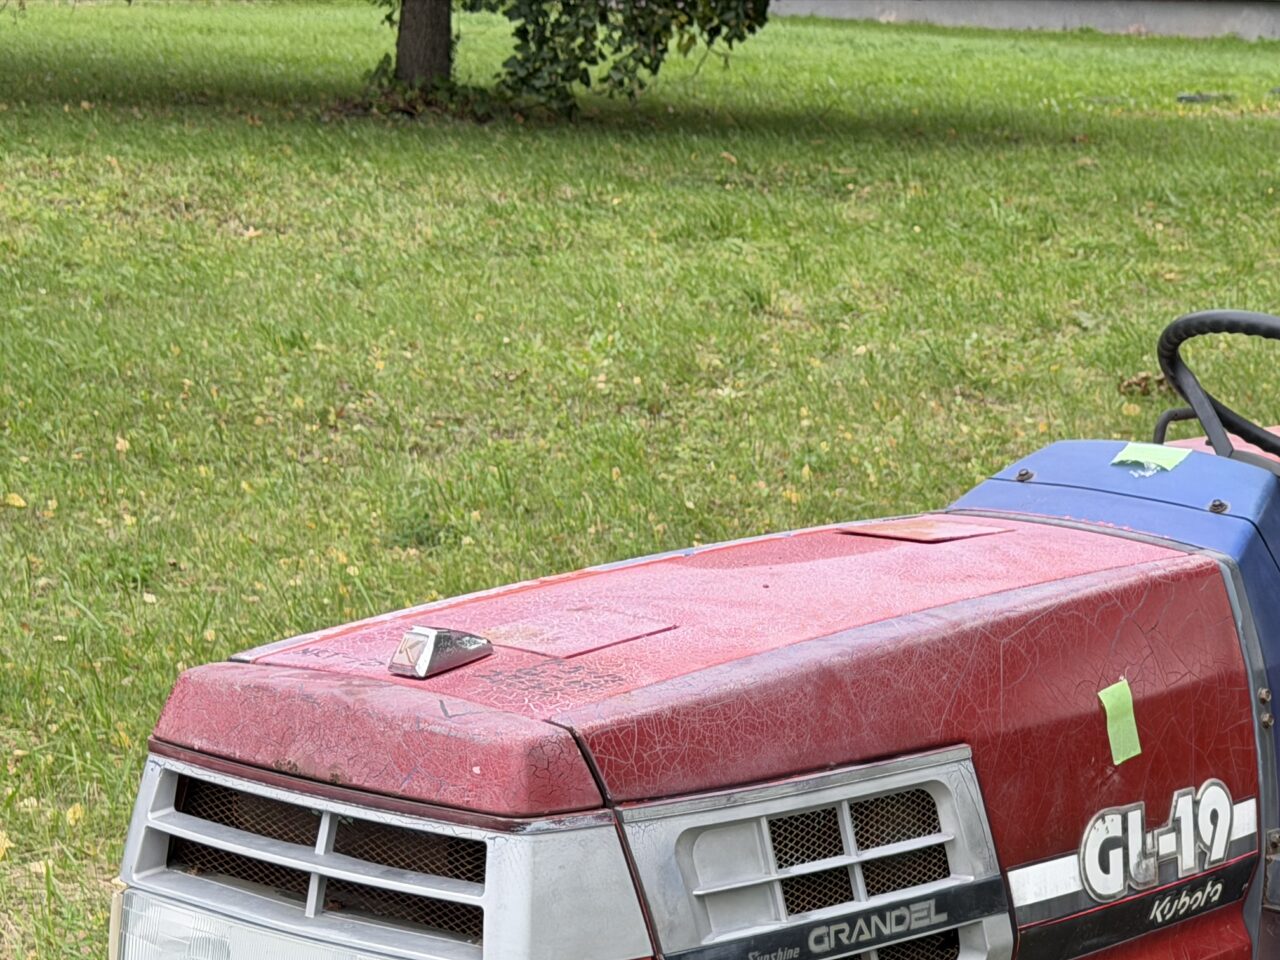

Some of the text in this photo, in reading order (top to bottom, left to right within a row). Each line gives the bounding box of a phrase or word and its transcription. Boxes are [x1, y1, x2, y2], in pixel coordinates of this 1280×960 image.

[1080, 778, 1234, 904] GL-19
[808, 898, 948, 954] GRANDEL
[1150, 881, 1223, 923] Kubota
